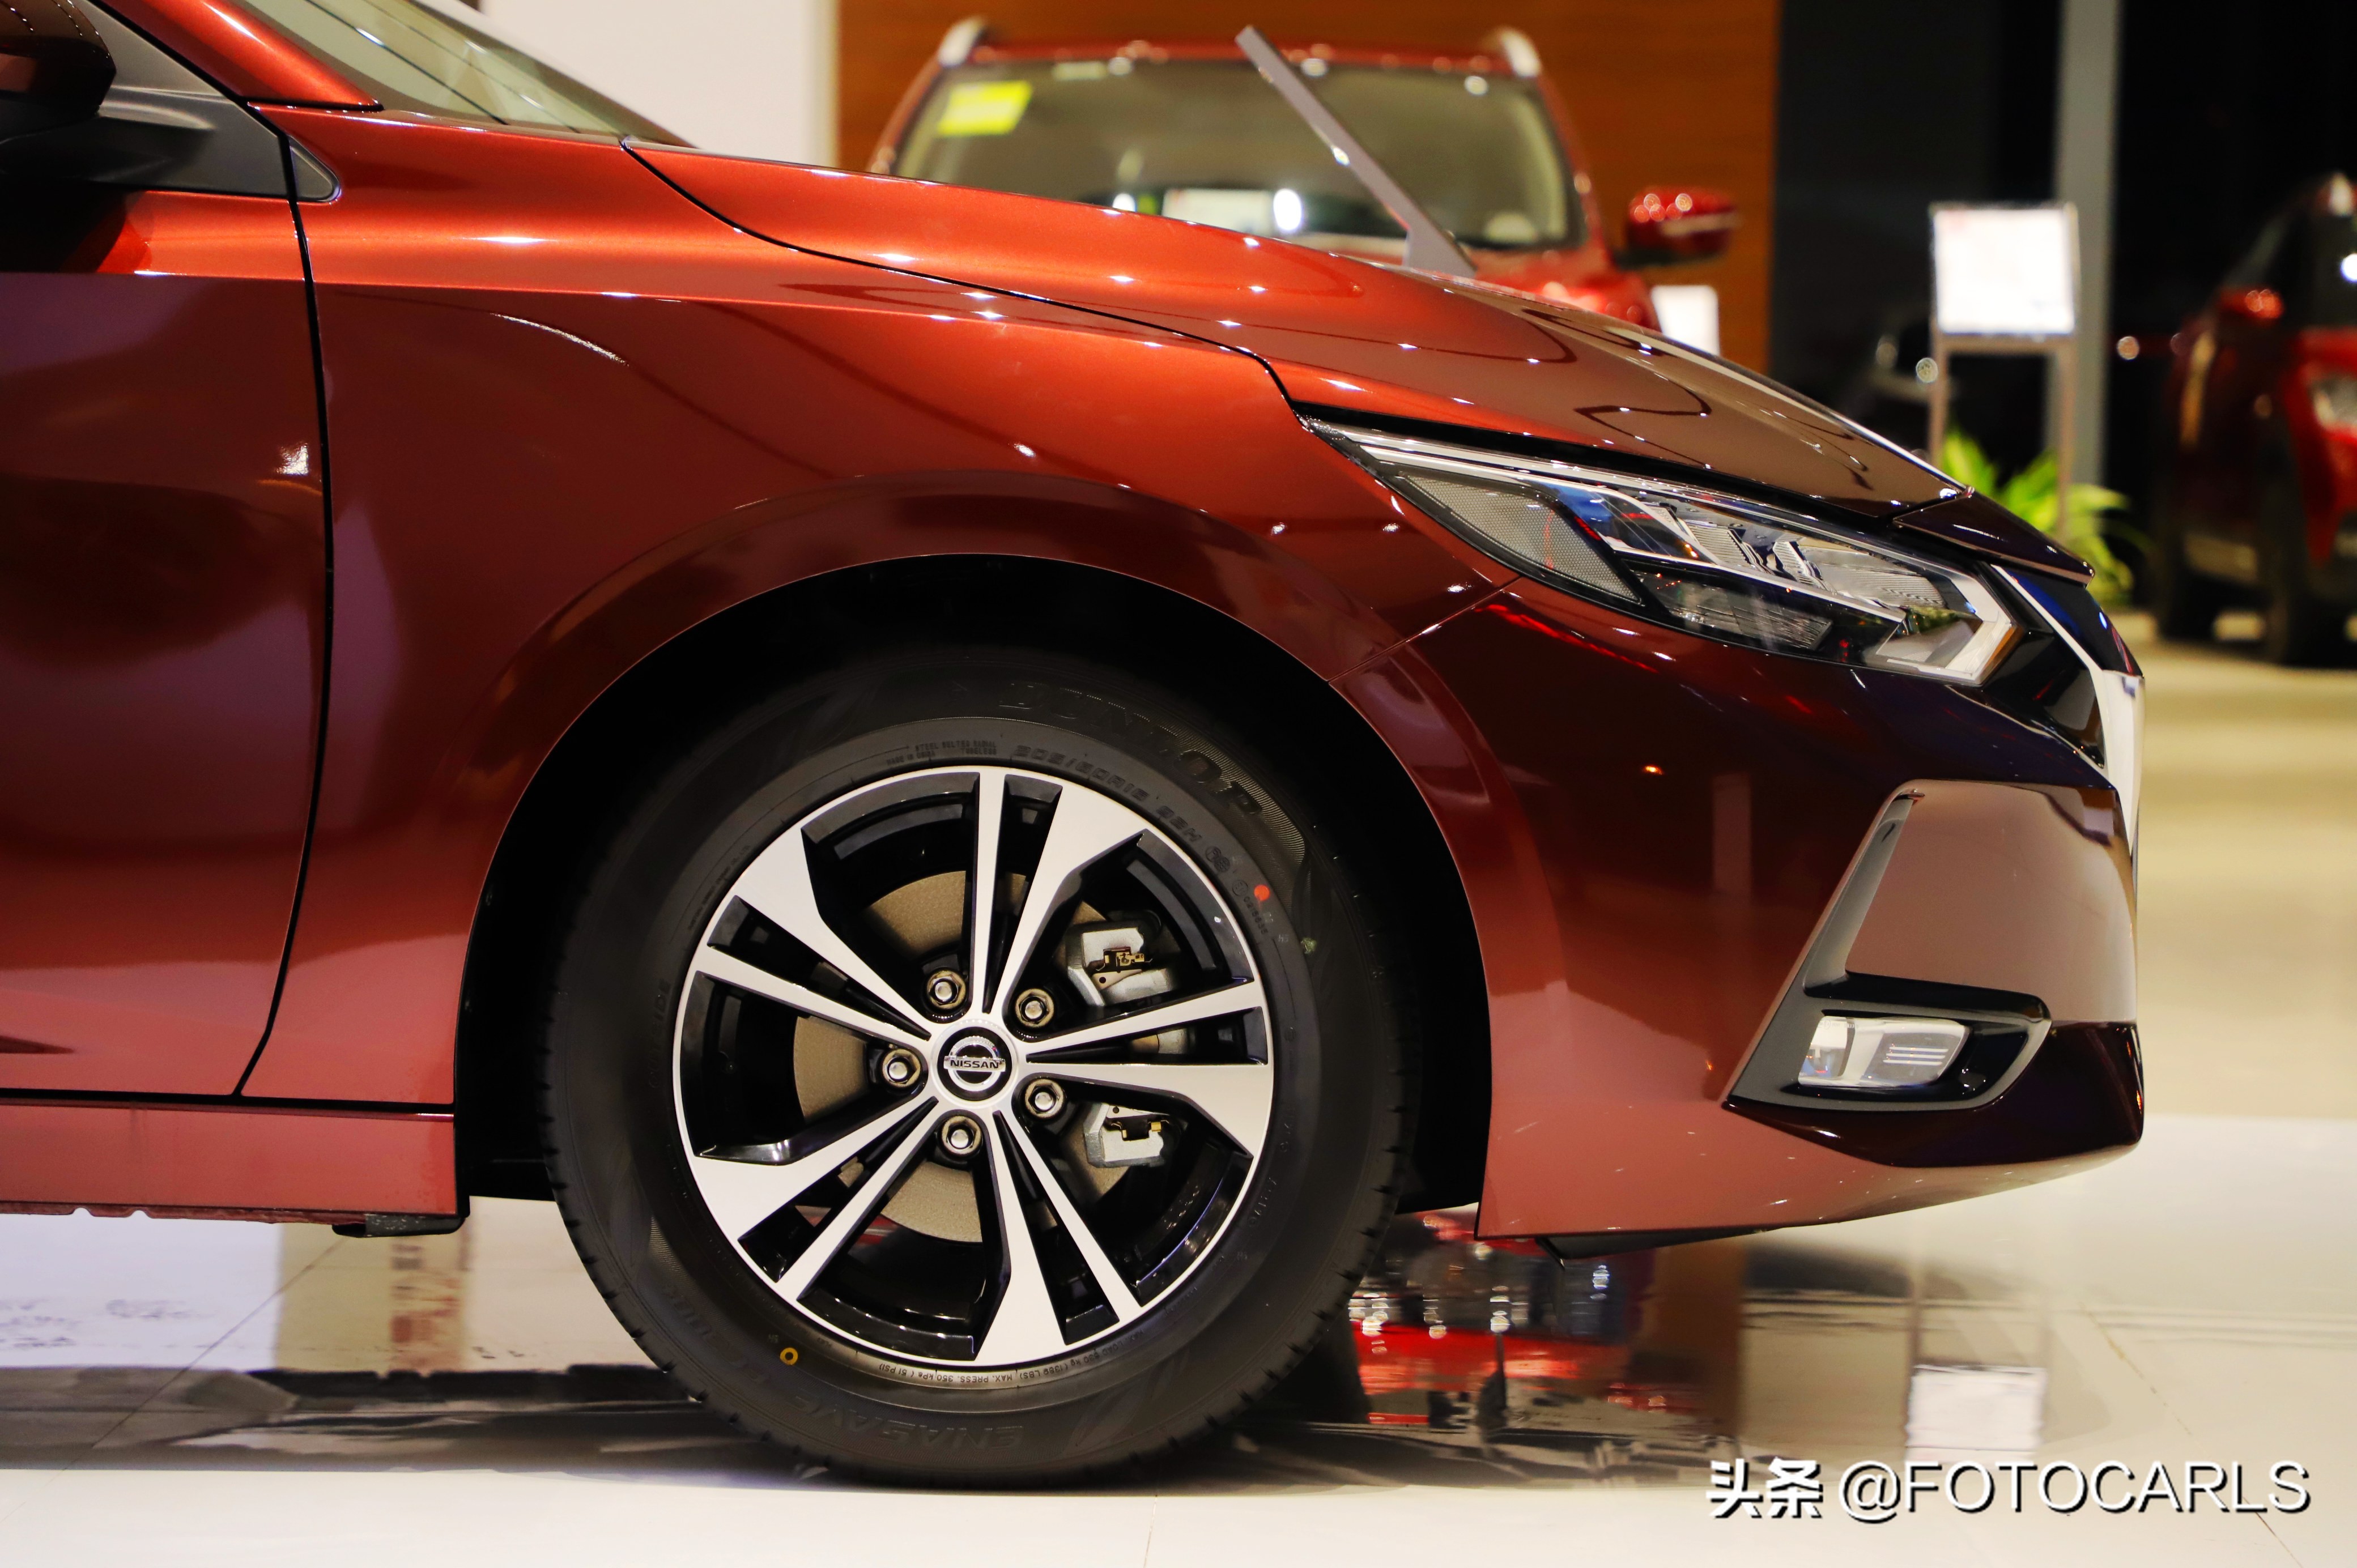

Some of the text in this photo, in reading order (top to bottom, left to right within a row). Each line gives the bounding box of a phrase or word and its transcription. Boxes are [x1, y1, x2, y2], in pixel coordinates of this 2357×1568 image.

[999, 680, 1263, 816] DUNLOP
[950, 1059, 999, 1068] NISSAN
[917, 1371, 933, 1380] kPa
[992, 1374, 1012, 1382] MAX.
[1018, 1369, 1040, 1380] LBS)
[789, 1394, 1024, 1450] ENASAVE
